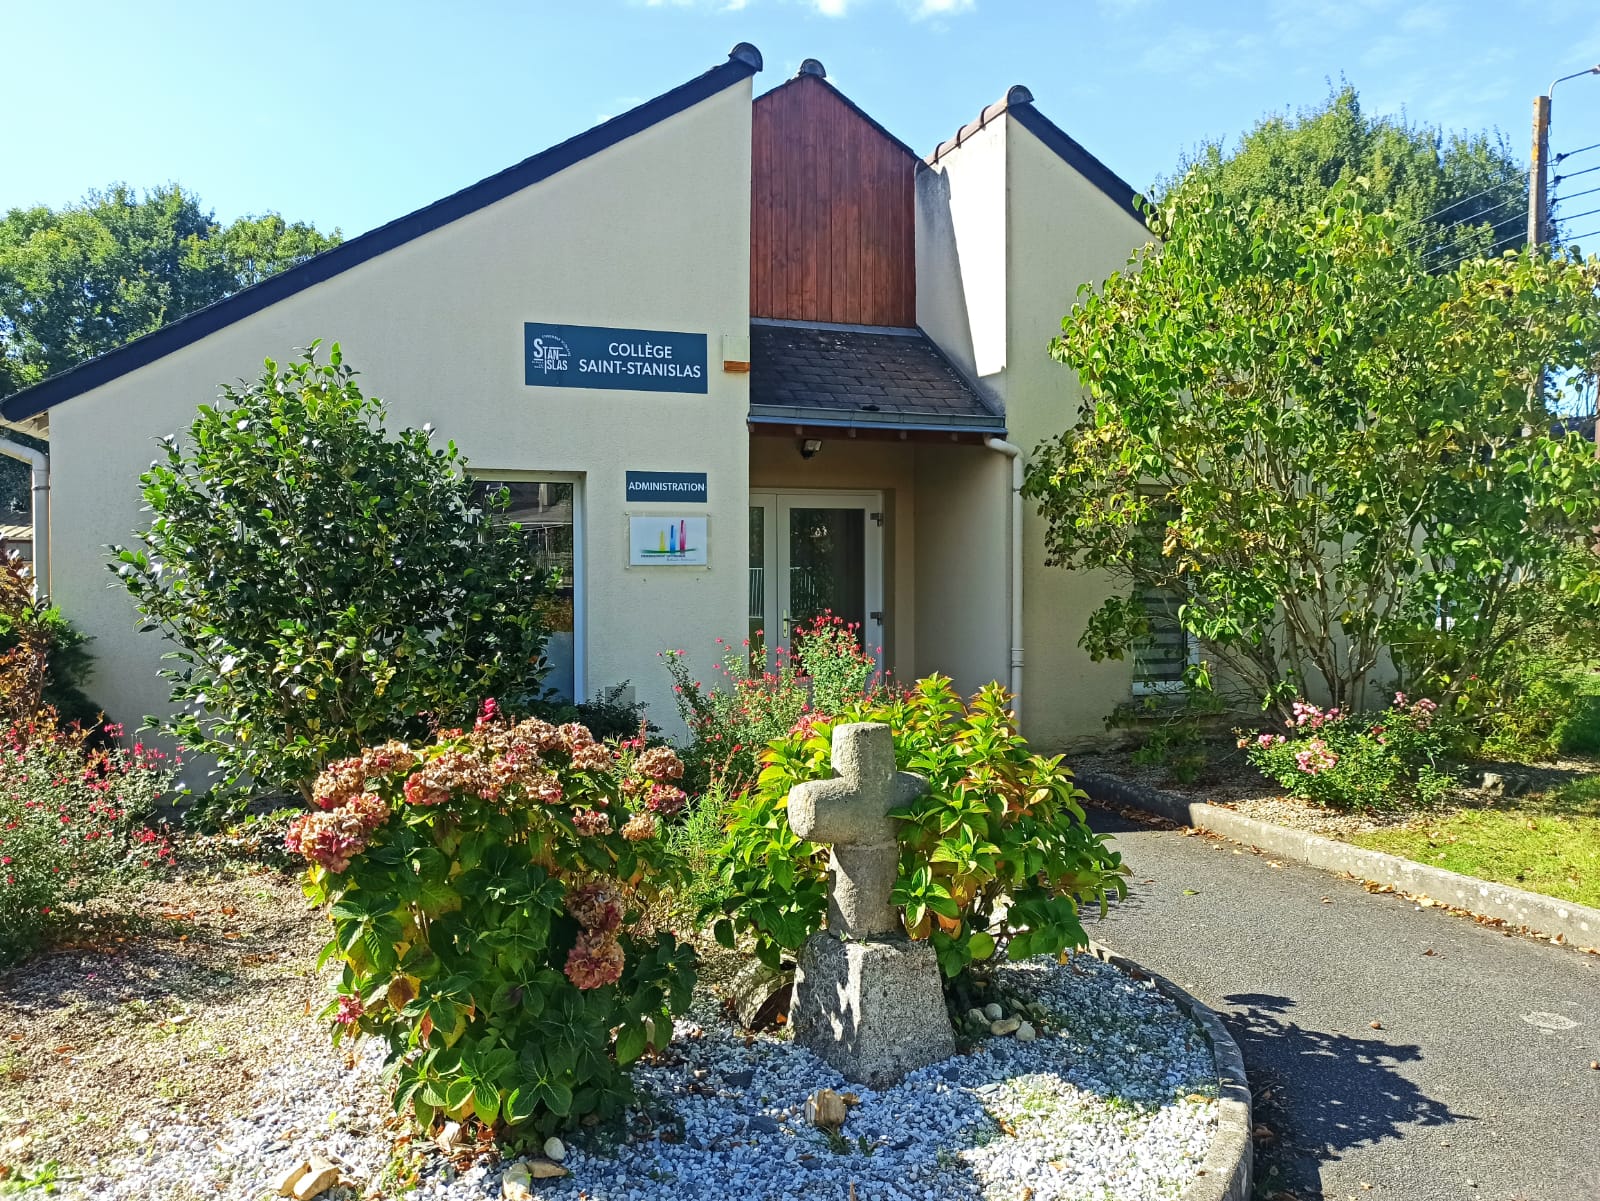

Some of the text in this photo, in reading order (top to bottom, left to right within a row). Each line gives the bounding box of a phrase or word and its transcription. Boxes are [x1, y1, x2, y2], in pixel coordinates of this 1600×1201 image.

[608, 341, 673, 359] COLLÈGE
[579, 359, 701, 378] SAINT-STANISLAS
[628, 481, 705, 492] ADMINISTRATION
